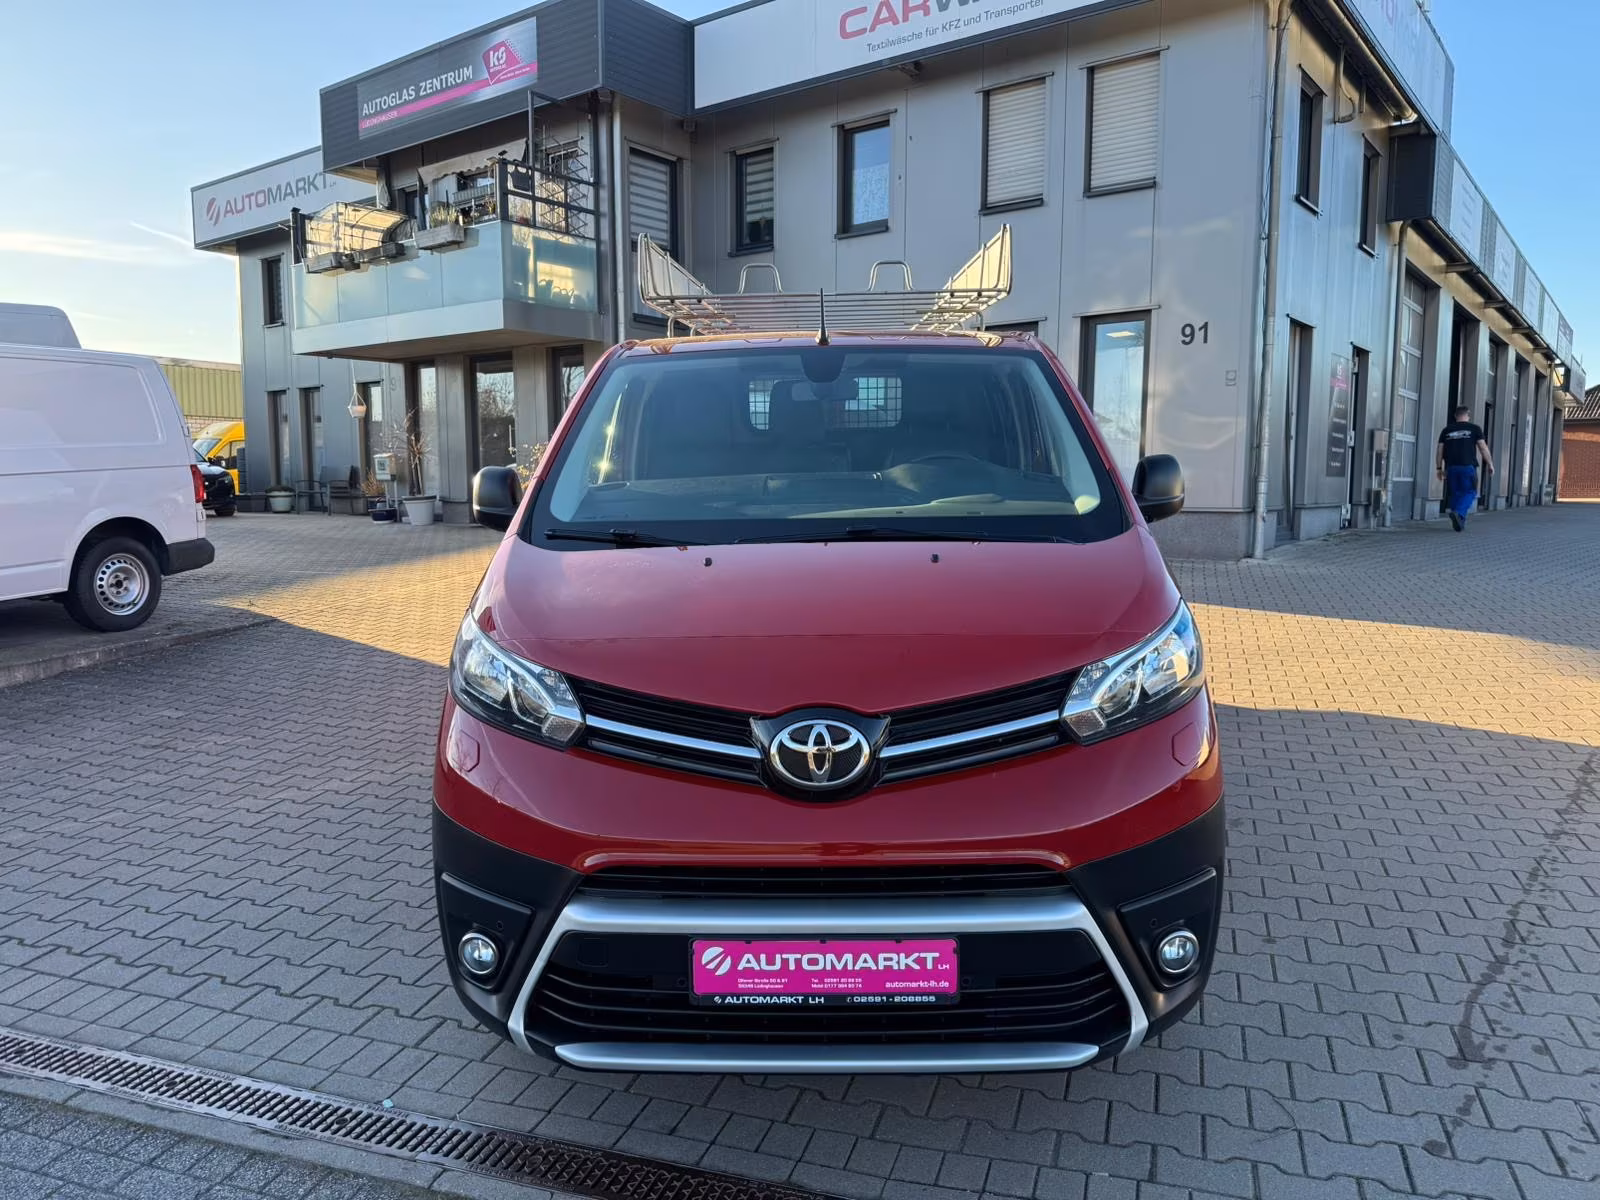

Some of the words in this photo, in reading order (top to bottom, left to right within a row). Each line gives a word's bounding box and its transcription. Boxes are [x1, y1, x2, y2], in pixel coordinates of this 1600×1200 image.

[867, 31, 923, 53] Textilwäsche
[925, 26, 939, 37] für
[942, 19, 960, 33] KFZ
[963, 13, 981, 27] und
[362, 86, 415, 116] AUTOGLAS
[420, 65, 473, 96] ZENTRUM
[223, 173, 327, 218] AUTOMARKT
[1181, 321, 1208, 346] 91
[737, 952, 940, 971] AUTOMARKT
[885, 980, 950, 988] automarkt-lh.de
[724, 996, 804, 1004] AUTOMARKT
[808, 996, 825, 1004] LH
